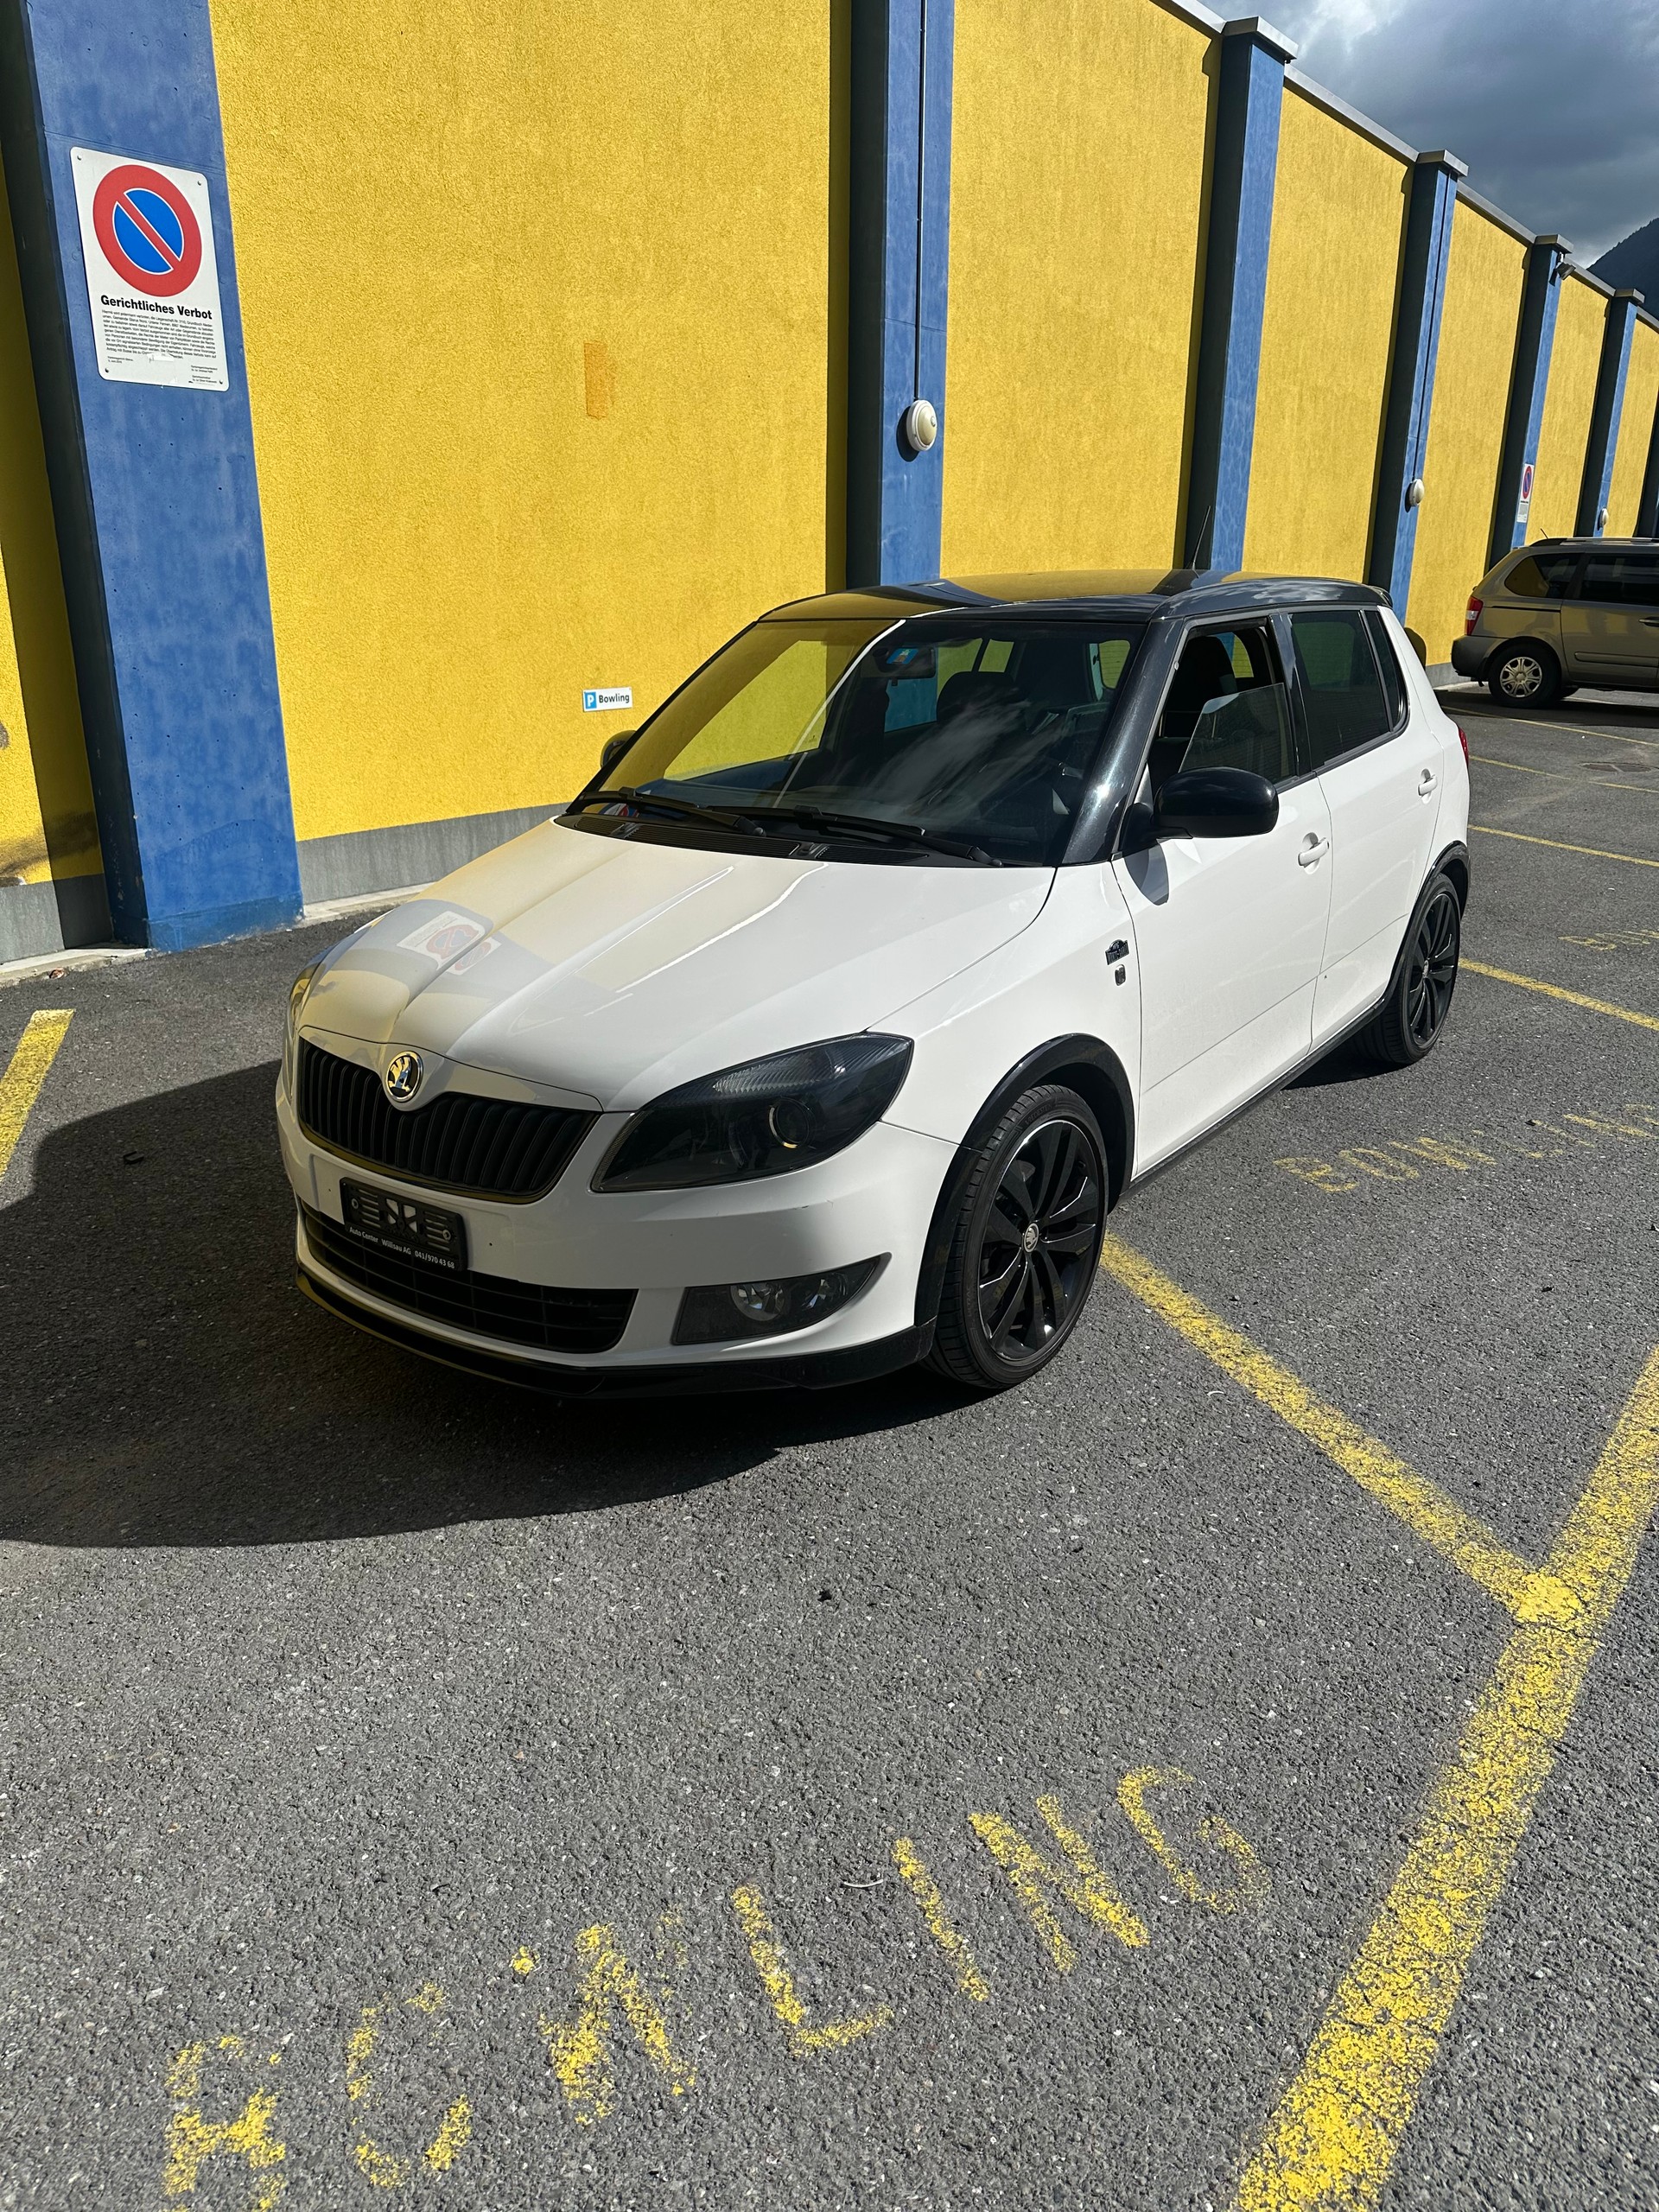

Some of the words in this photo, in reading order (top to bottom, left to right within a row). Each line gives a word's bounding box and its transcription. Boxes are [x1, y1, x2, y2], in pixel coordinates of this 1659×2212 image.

[100, 295, 175, 315] Gerichtliches
[177, 305, 213, 320] Verbot
[599, 693, 630, 704] Bowling
[349, 1226, 362, 1237] Auto
[361, 1230, 379, 1243] Center
[381, 1237, 403, 1252] Willisau
[402, 1246, 412, 1255] AG
[414, 1249, 439, 1264] 041/970
[438, 1257, 447, 1267] 43
[446, 1260, 455, 1269] 68
